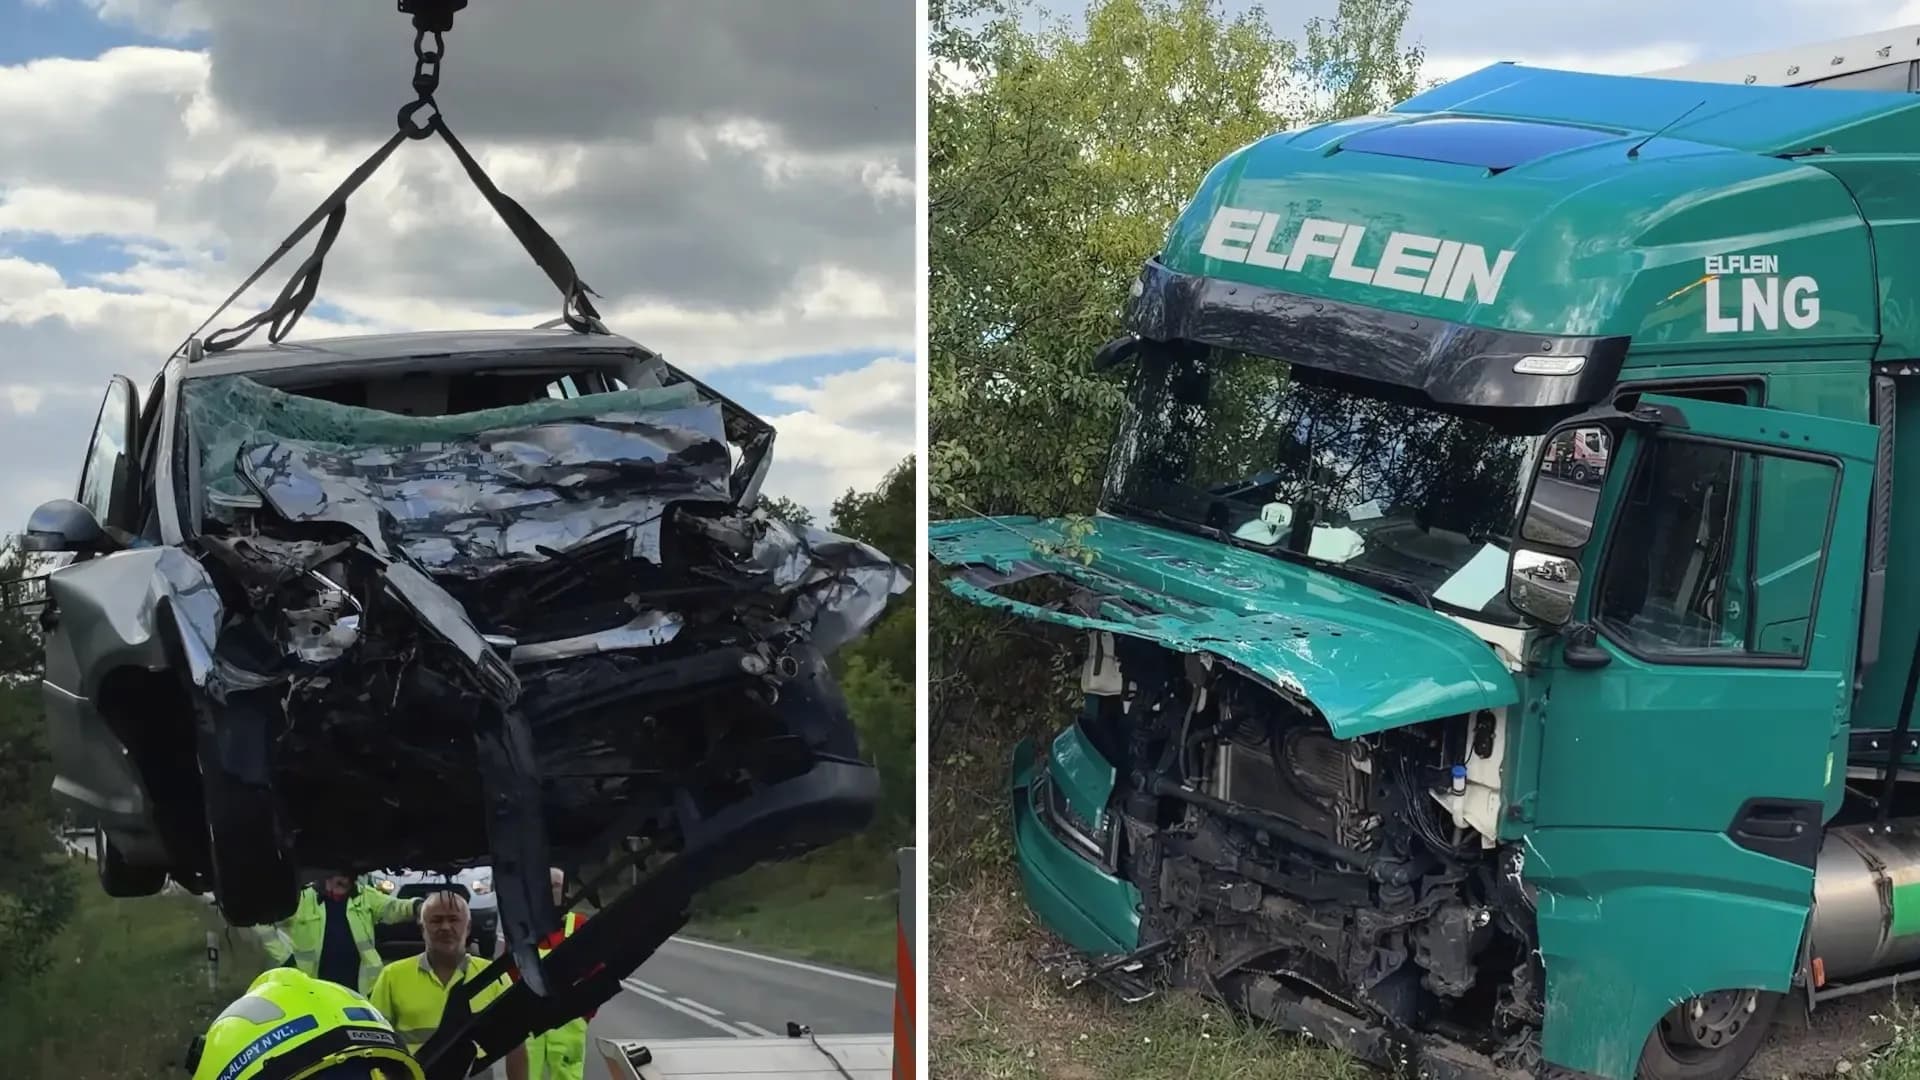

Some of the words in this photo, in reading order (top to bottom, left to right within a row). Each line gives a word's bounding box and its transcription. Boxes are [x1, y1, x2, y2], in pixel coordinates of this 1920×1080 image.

[1199, 206, 1516, 305] ELFLEIN
[1705, 255, 1778, 274] ELFLEIN
[1706, 276, 1820, 333] LNG
[262, 1036, 273, 1049] N
[352, 1032, 393, 1042] MSA
